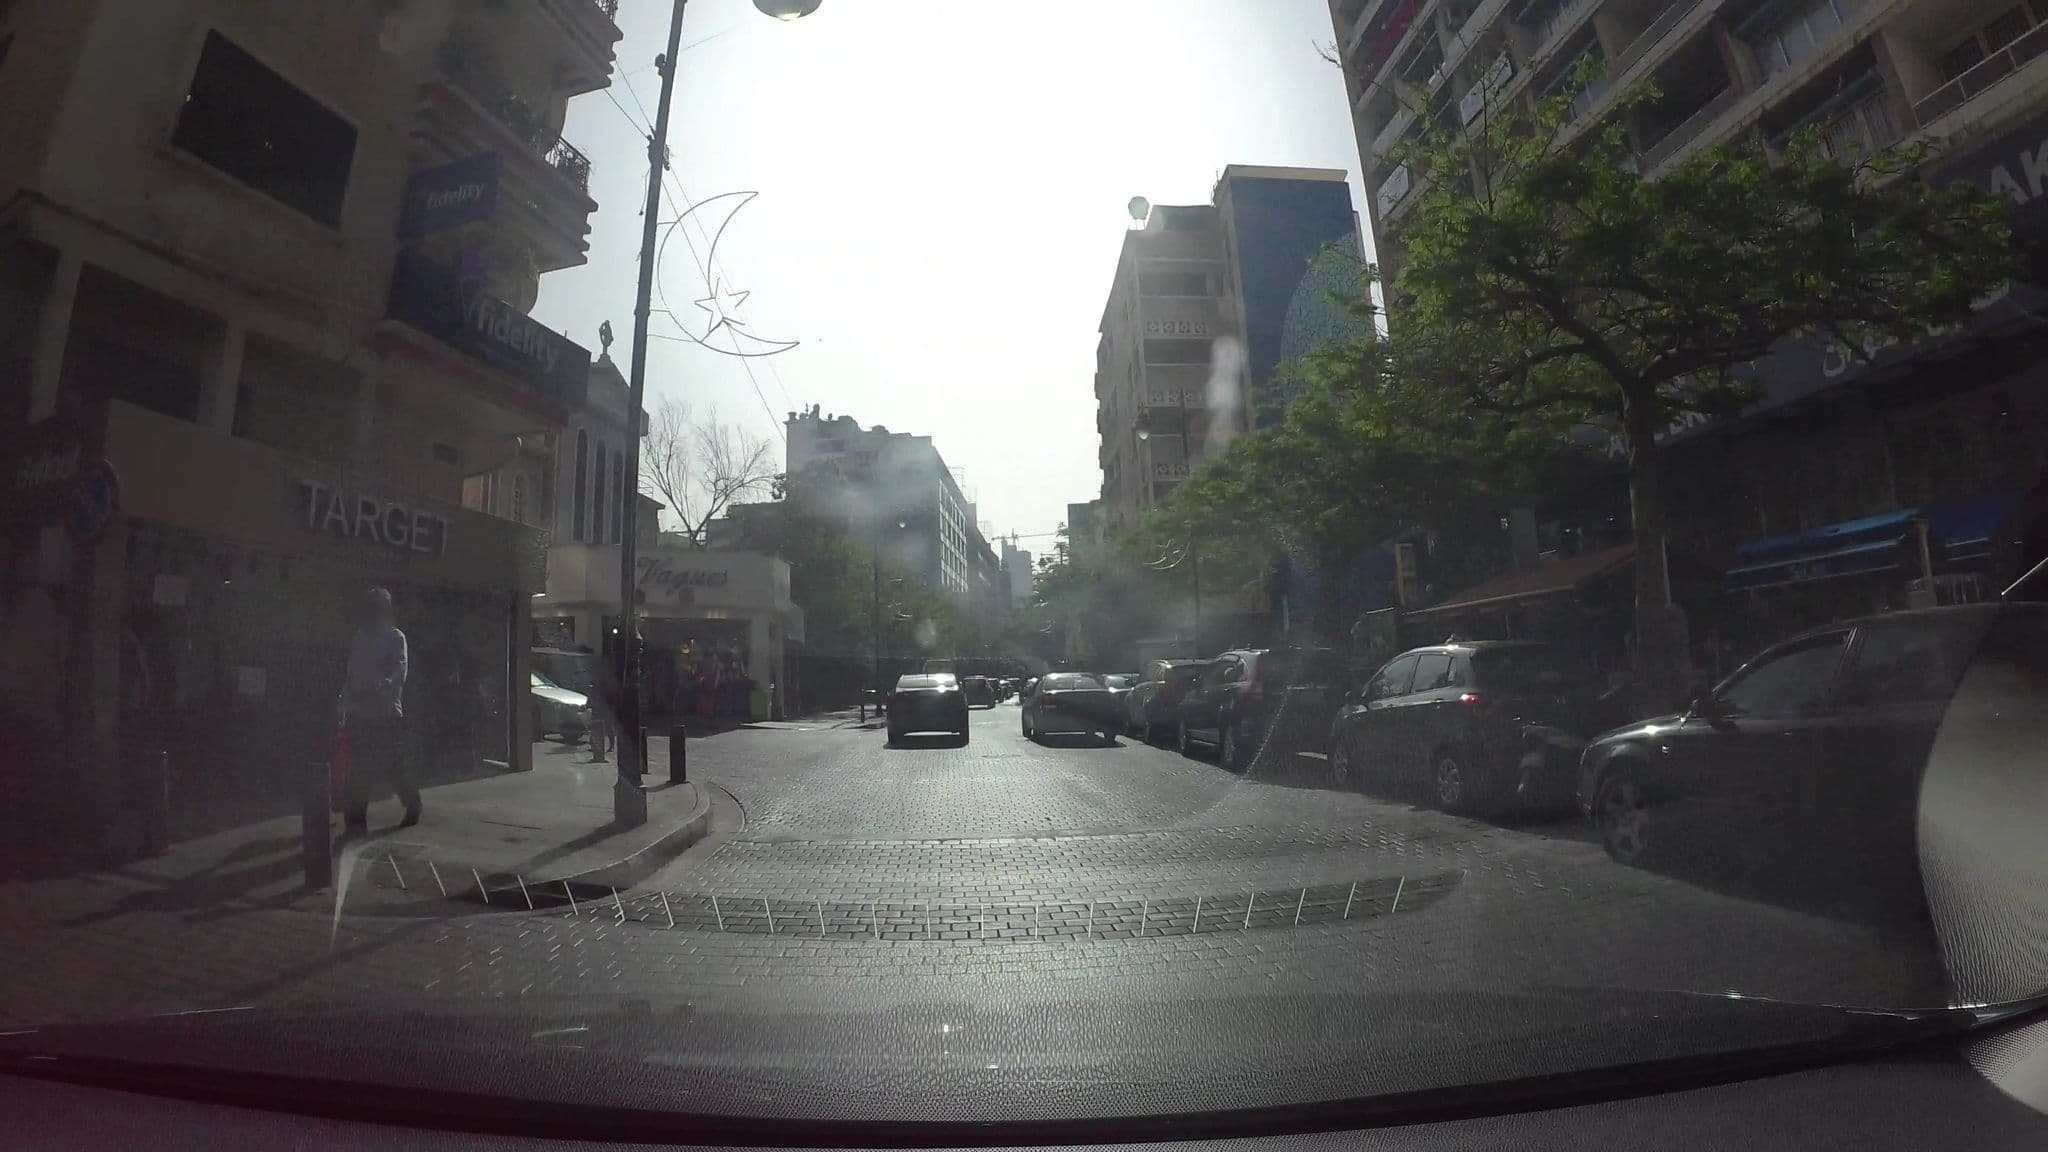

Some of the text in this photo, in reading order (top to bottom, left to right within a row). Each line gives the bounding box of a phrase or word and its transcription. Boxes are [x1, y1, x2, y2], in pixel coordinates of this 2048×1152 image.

[426, 183, 485, 210] fidelity
[476, 300, 559, 373] fidelity
[302, 479, 455, 555] TARGET
